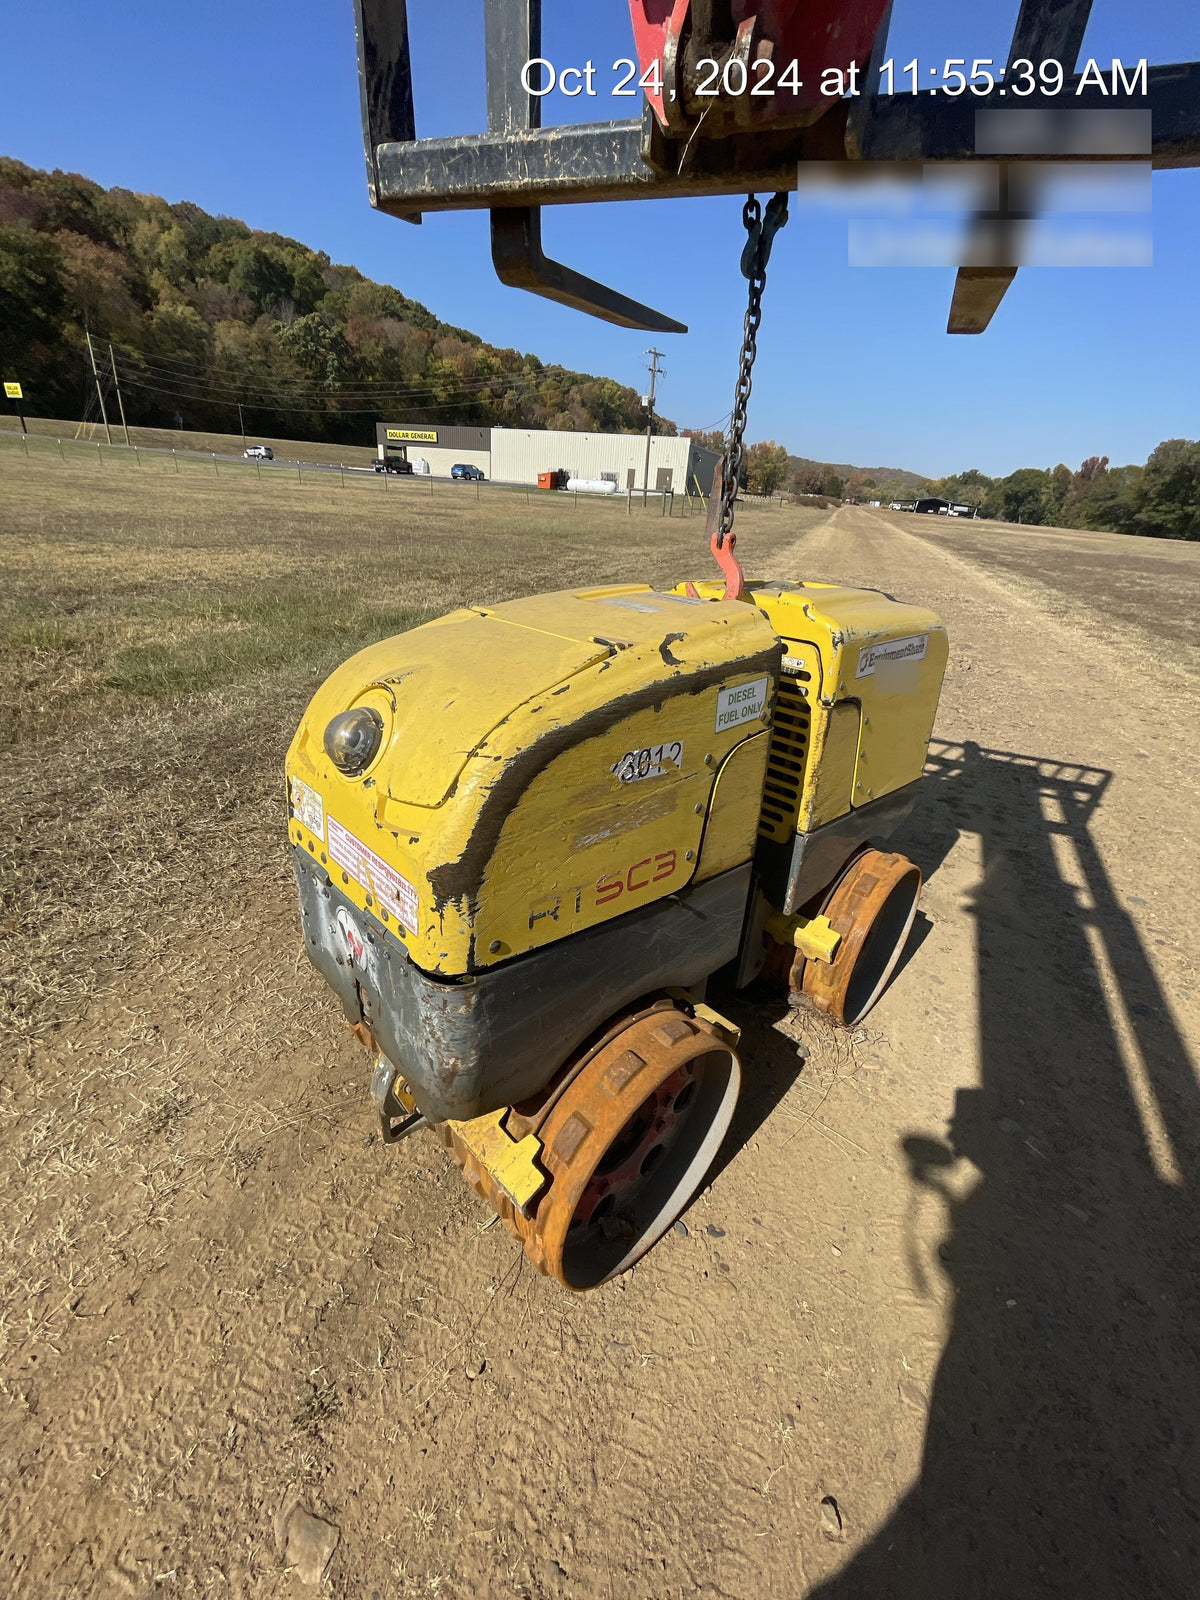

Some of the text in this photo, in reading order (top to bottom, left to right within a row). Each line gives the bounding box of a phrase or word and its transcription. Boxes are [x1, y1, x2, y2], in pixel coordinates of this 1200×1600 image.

[728, 686, 757, 706] DIESEL
[718, 700, 764, 727] FUEL ONLY
[345, 833, 418, 900] CUSTOMER RESPONSIBILITY
